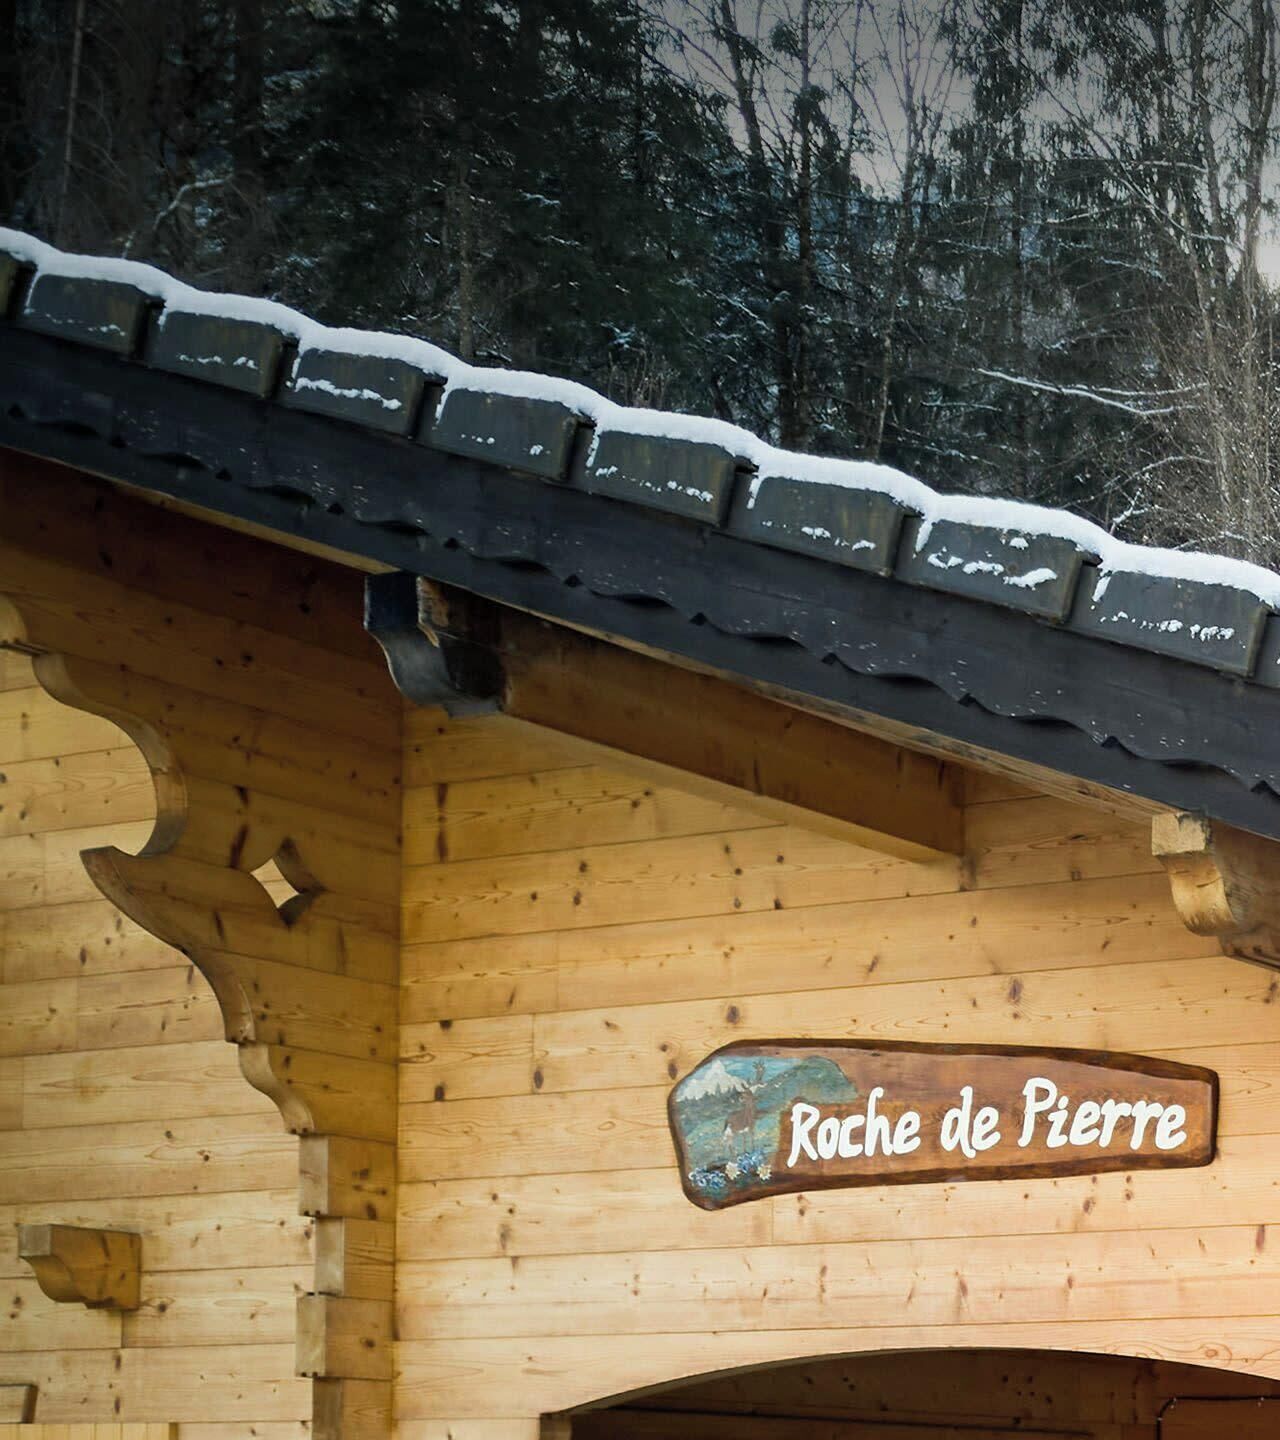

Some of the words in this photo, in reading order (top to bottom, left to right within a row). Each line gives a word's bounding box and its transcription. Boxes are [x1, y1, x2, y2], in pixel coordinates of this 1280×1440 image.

[787, 1087, 921, 1168] Roche
[941, 1087, 1001, 1158] de
[1018, 1077, 1187, 1150] Pierre
